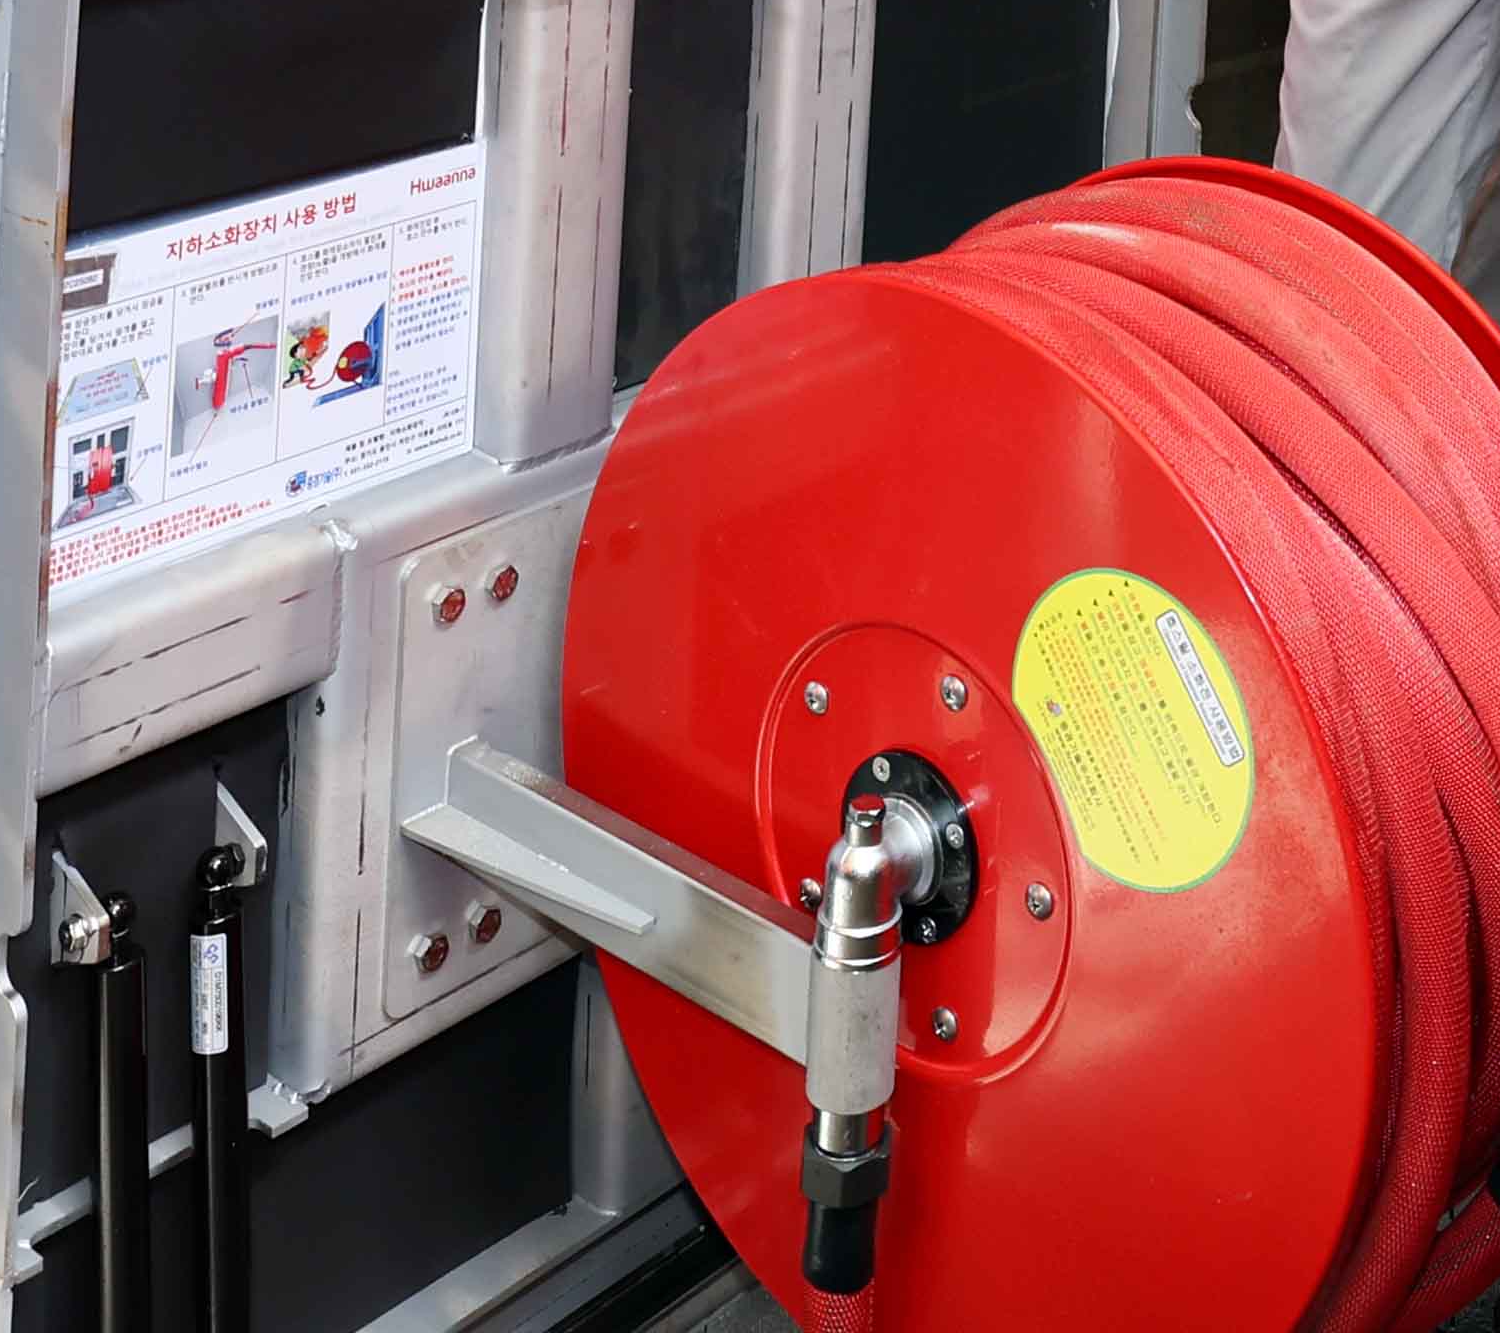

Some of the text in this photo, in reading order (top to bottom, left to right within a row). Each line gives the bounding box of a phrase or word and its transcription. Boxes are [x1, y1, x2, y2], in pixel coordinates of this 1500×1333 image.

[410, 166, 477, 197] Hwaanna
[166, 192, 357, 261] 지하소화장치 사용 방법
